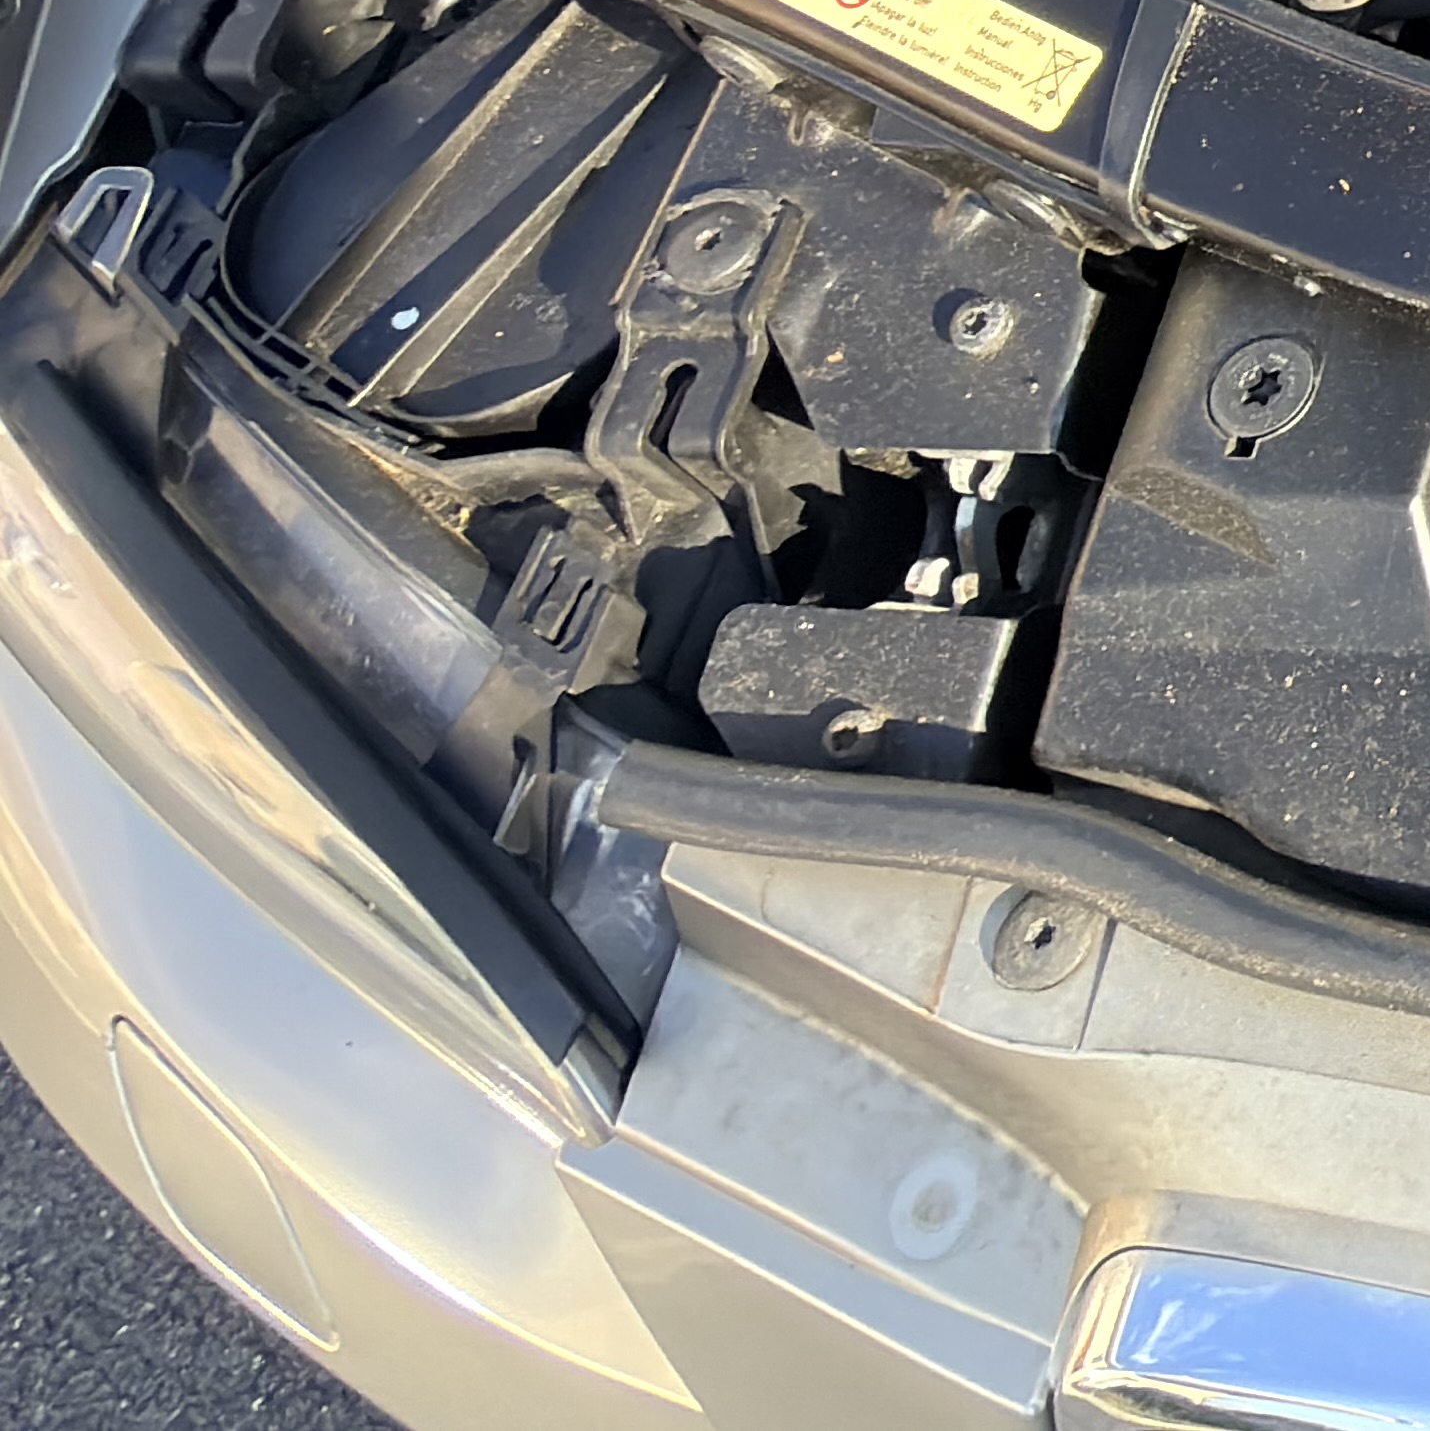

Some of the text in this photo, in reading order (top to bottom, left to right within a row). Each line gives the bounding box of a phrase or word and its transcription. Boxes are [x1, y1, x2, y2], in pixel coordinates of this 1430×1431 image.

[898, 35, 907, 45] la
[977, 27, 1013, 48] Manual
[965, 45, 1024, 81] Instrucciones
[954, 62, 1001, 92] Instruction
